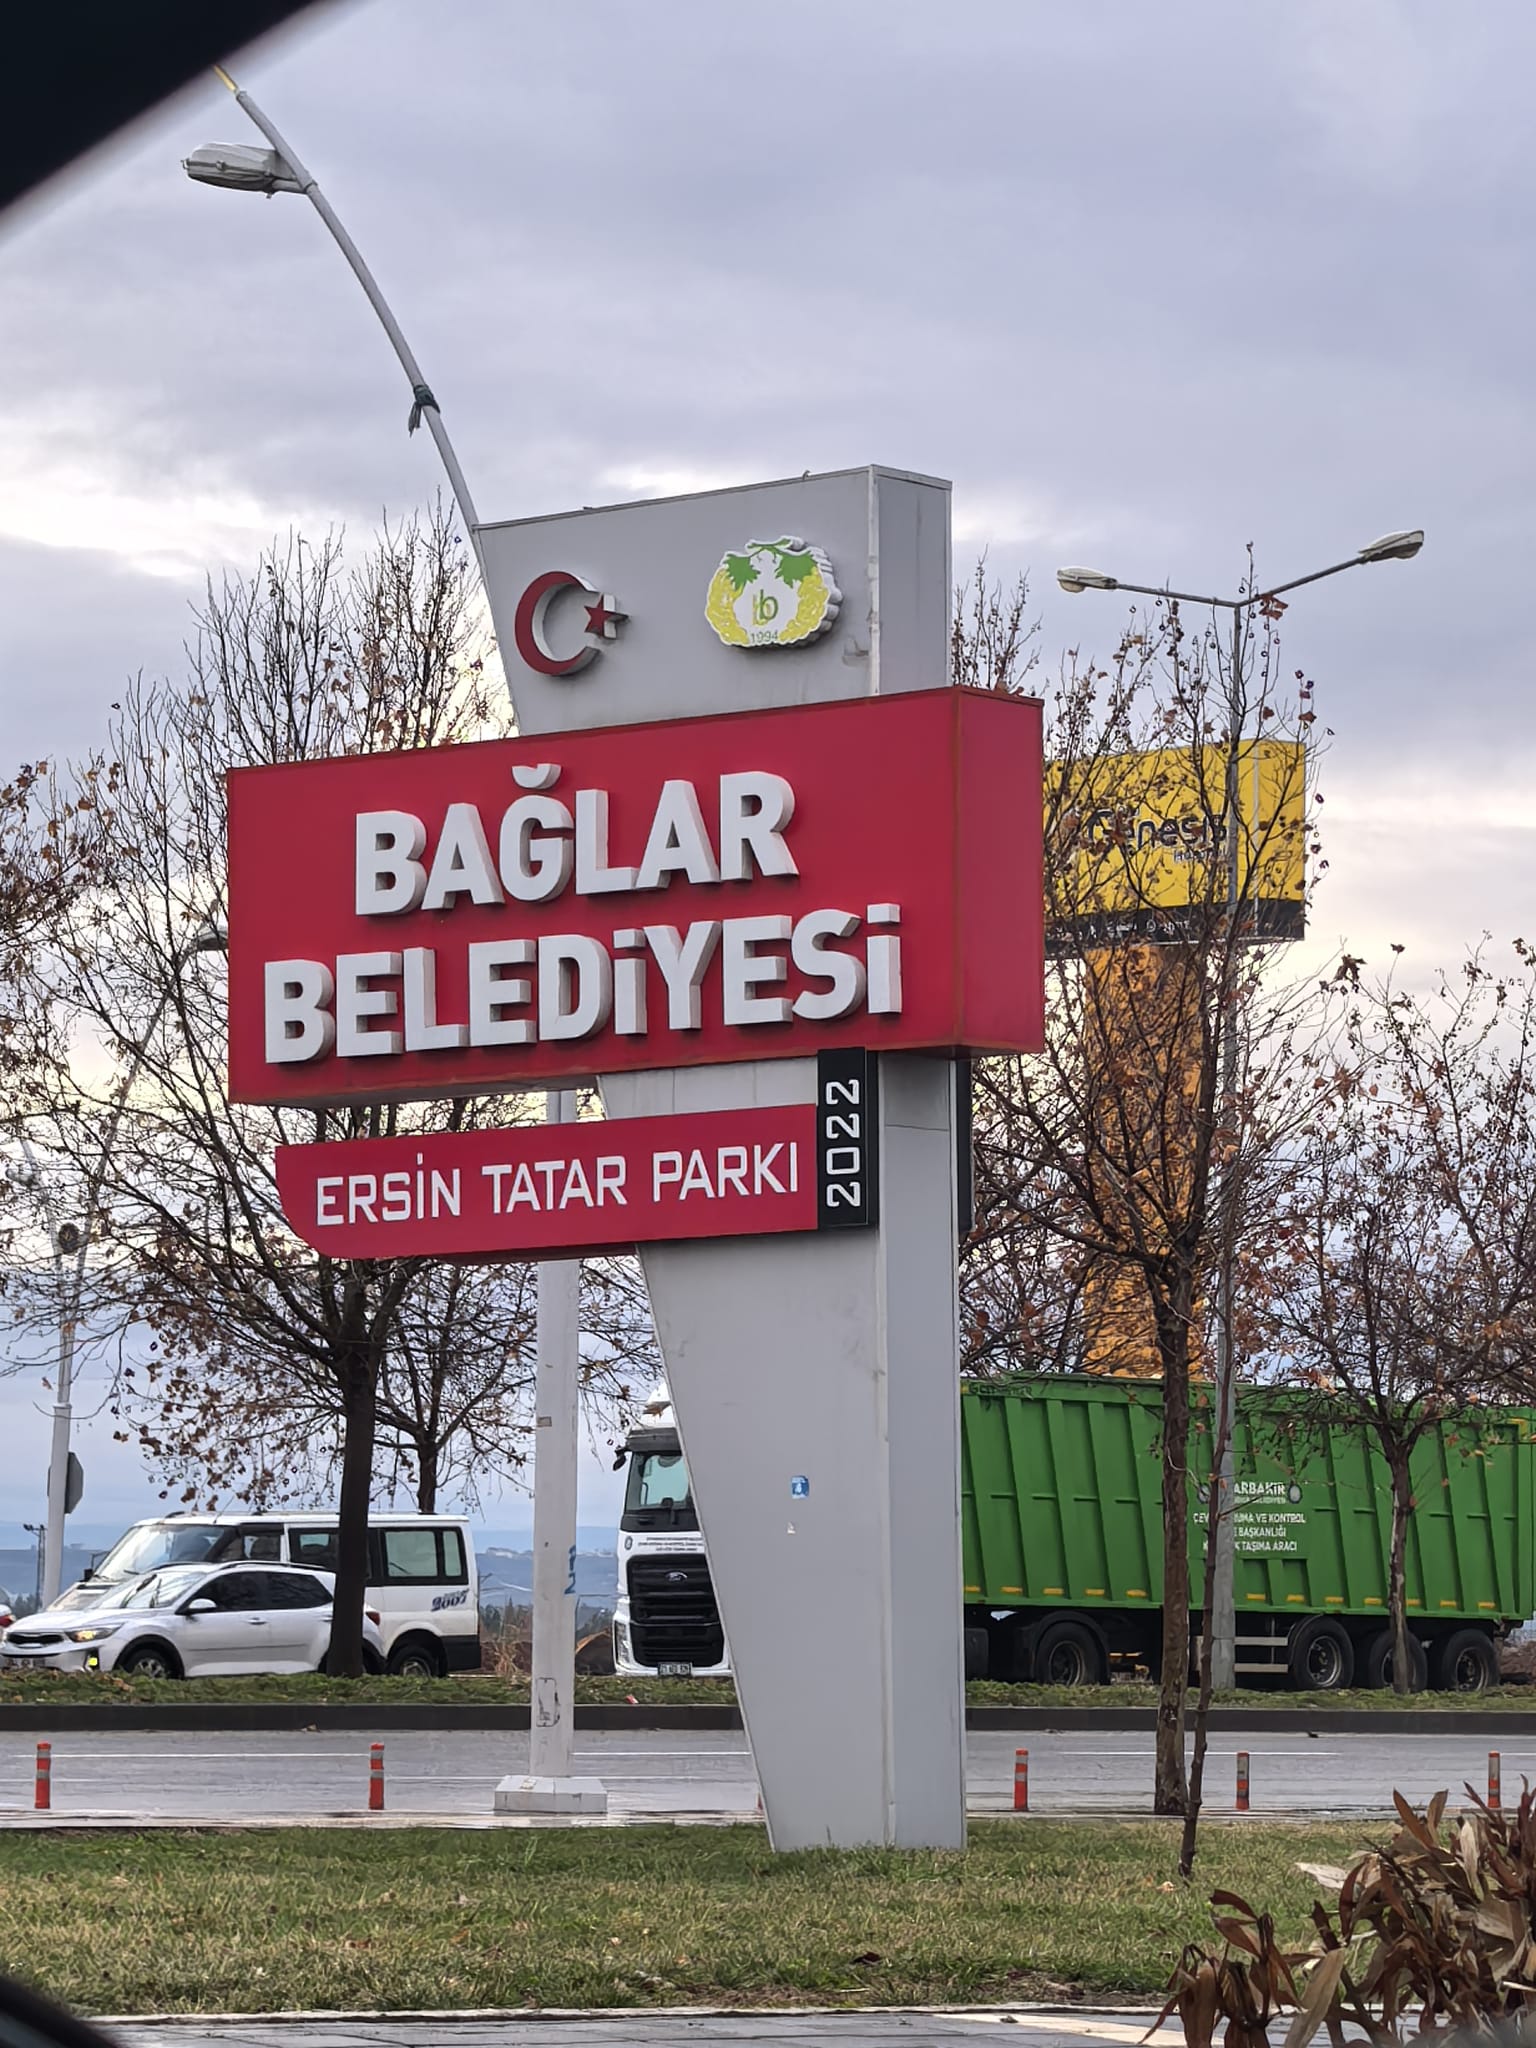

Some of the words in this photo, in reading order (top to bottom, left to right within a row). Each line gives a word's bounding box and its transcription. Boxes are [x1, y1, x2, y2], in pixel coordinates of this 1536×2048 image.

[751, 630, 778, 643] 1994
[356, 764, 799, 915] BAĞLAR
[317, 1153, 460, 1226] ERSİN
[482, 1156, 627, 1214] TATAR
[652, 1142, 798, 1202] PARKI
[826, 1079, 861, 1207] 2022
[1269, 1513, 1306, 1523] KONTROL
